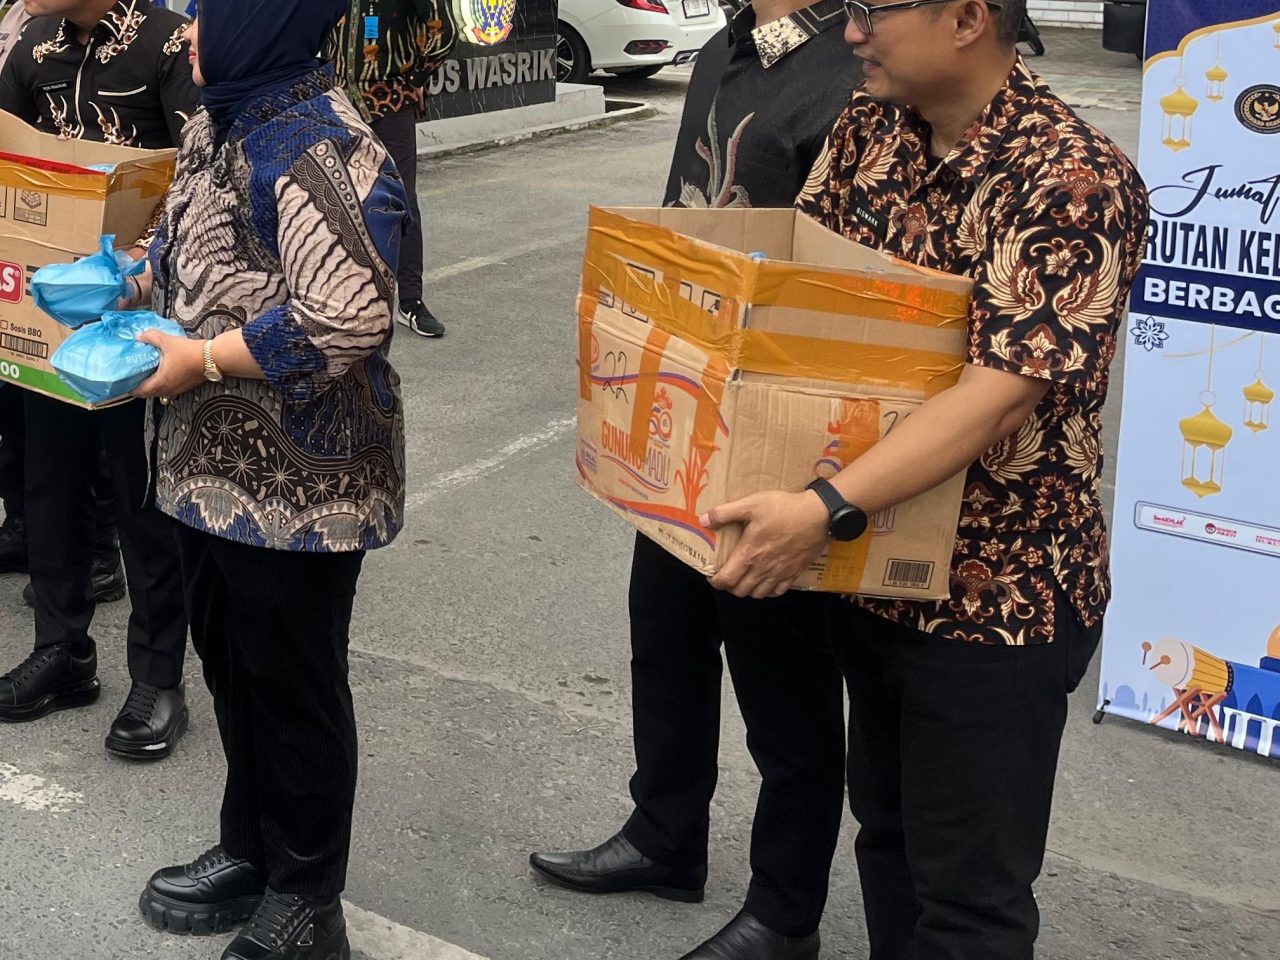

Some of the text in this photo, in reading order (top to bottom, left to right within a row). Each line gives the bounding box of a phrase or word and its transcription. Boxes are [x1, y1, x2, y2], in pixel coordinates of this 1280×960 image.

[466, 48, 555, 90] WASRIK
[856, 206, 878, 227] BISMARK
[1146, 218, 1229, 270] RUTAN
[10, 322, 42, 338] Sosis BBQ
[603, 351, 629, 404] 22
